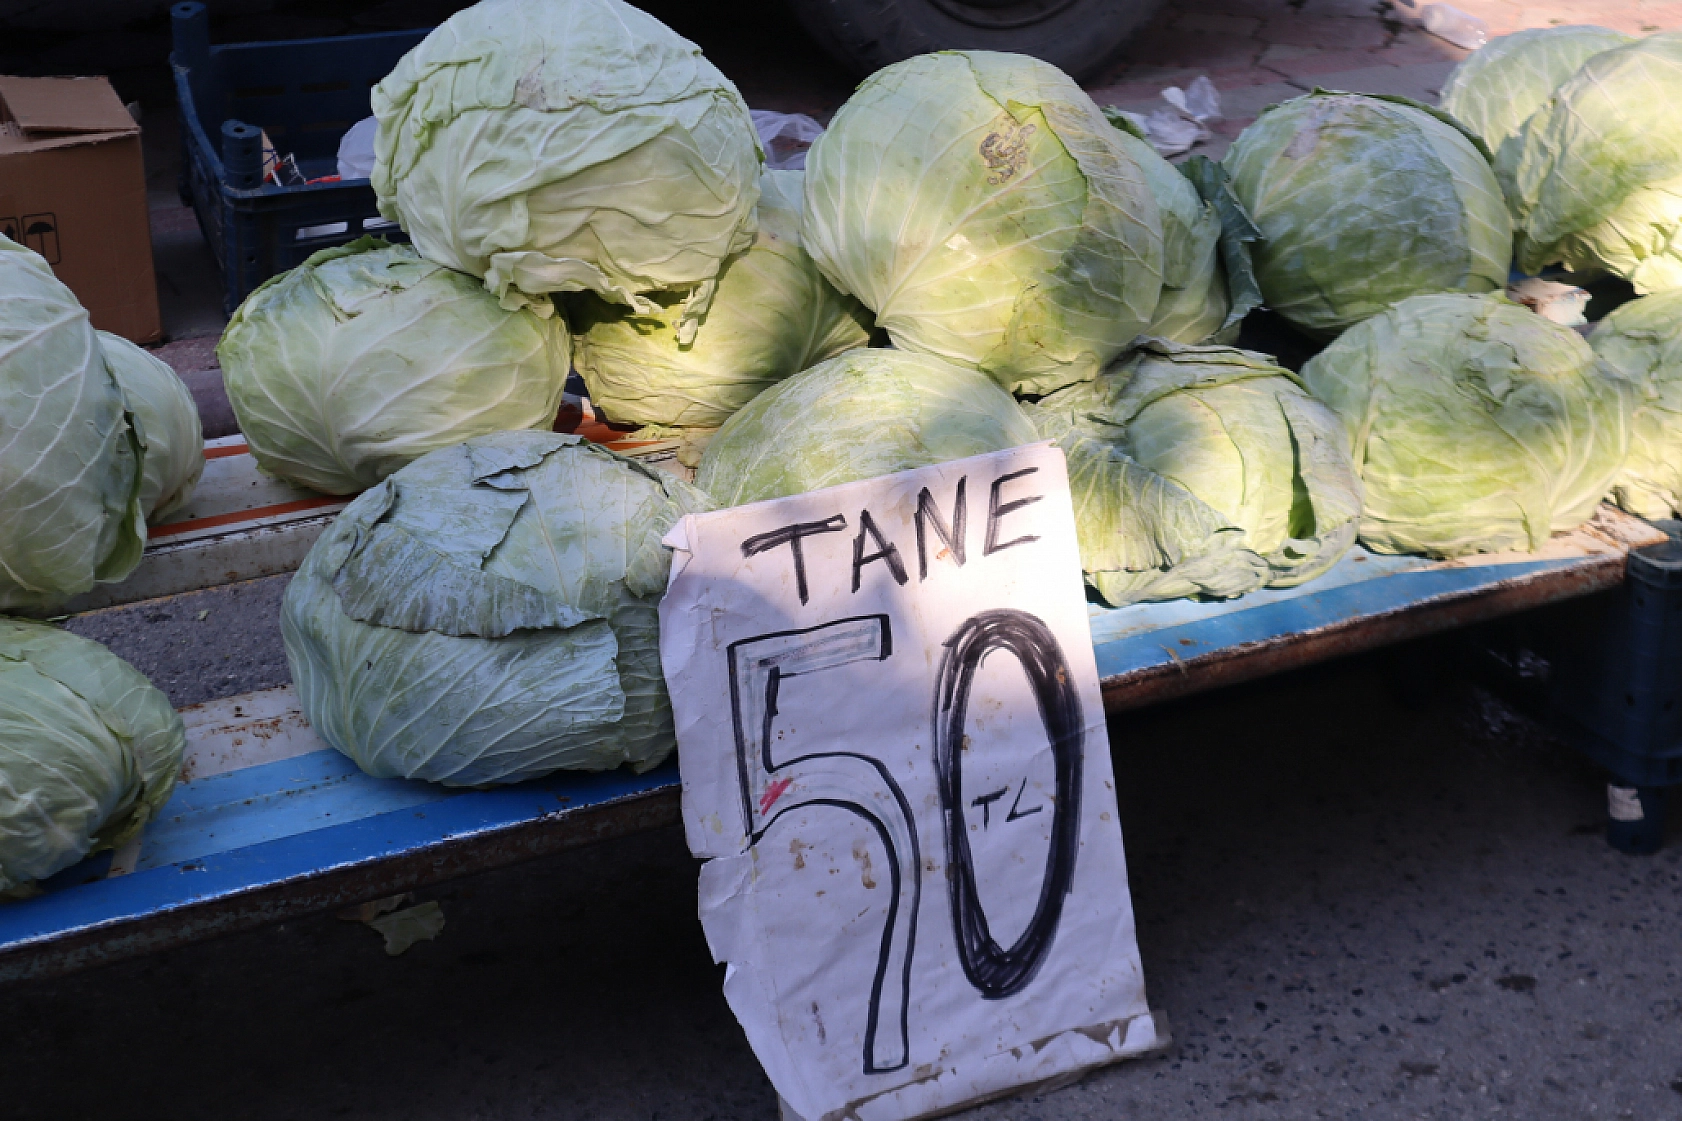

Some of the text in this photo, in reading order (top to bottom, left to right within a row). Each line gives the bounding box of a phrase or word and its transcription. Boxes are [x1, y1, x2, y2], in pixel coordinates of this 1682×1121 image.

[741, 467, 1044, 606] TANE
[727, 608, 1085, 1075] 50
[971, 776, 1043, 831] TL
